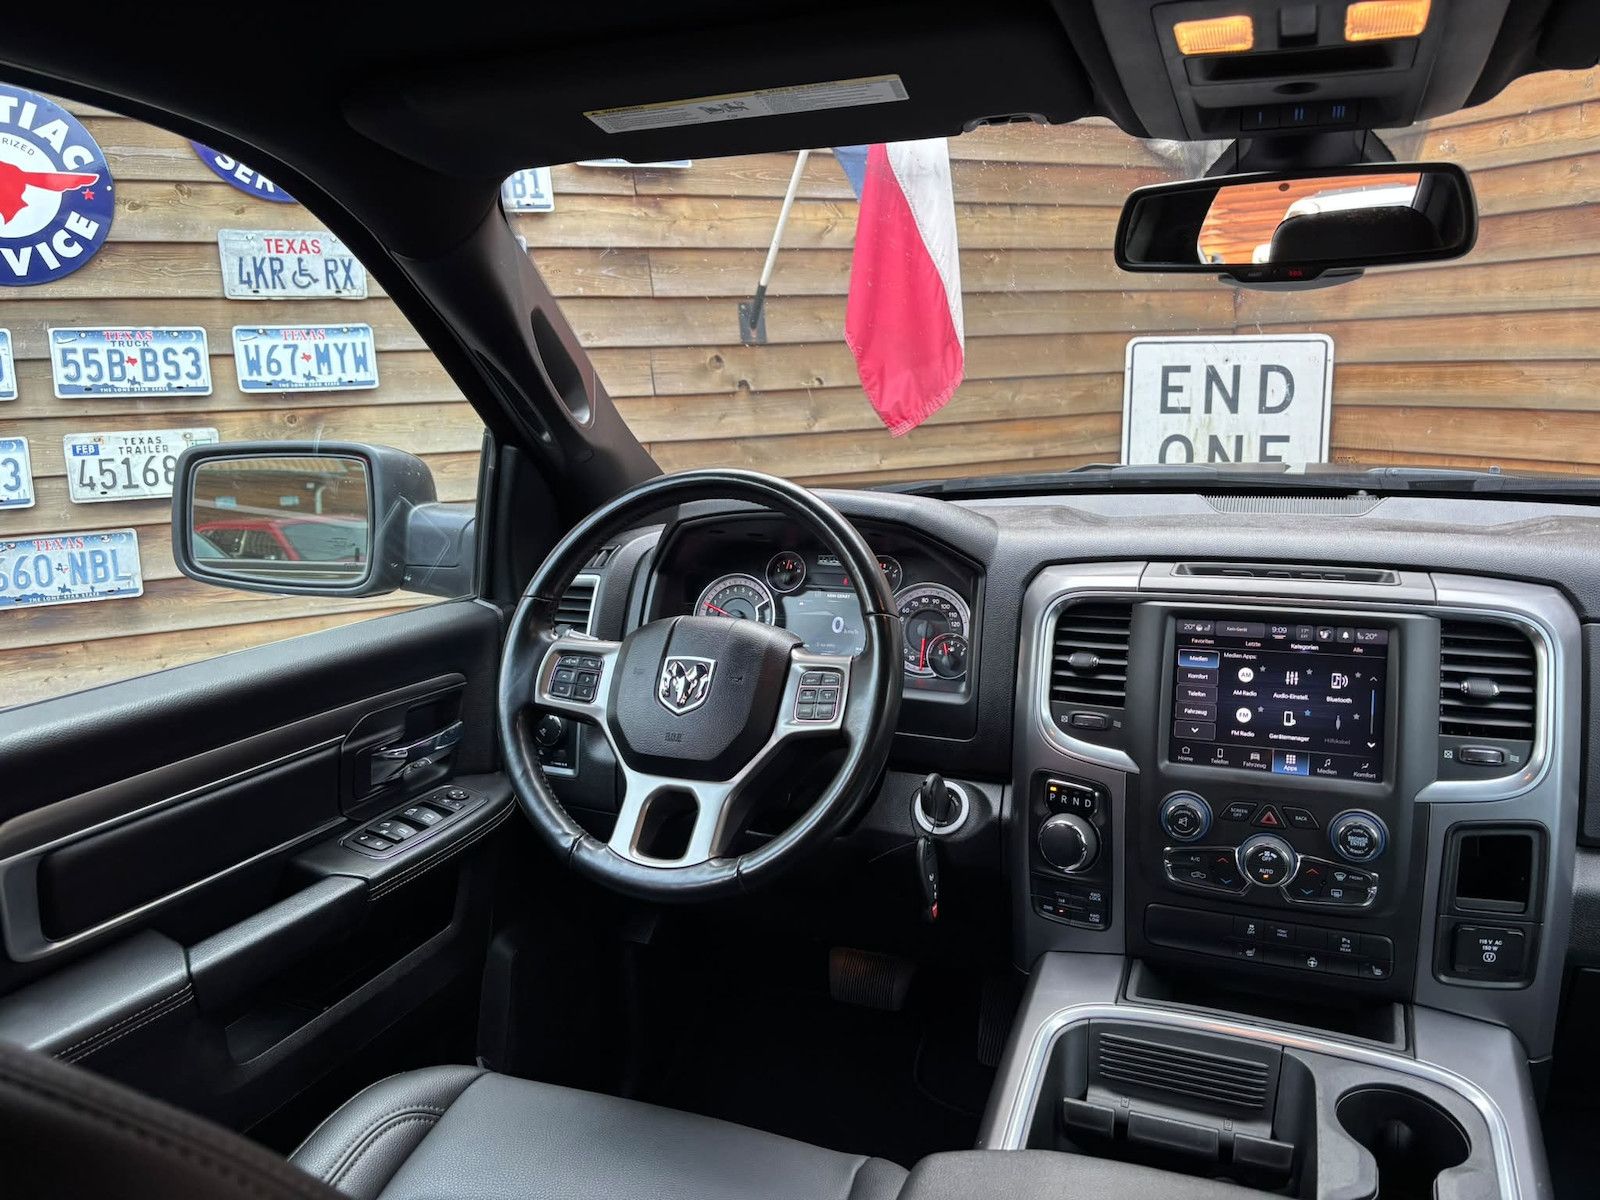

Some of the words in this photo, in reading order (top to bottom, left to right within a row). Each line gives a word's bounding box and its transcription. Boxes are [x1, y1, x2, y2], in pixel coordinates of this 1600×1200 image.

[264, 238, 321, 254] TEXAS
[238, 256, 287, 289] 4KR
[324, 258, 356, 290] RX
[103, 331, 153, 341] TEXAS
[282, 329, 326, 340] TEXAS
[110, 340, 150, 348] TRUCK
[244, 344, 299, 377] W67
[314, 342, 369, 376] MYW
[60, 347, 127, 383] 55B
[139, 346, 201, 382] BS3
[1159, 364, 1295, 414] END
[123, 437, 162, 446] TEXAS
[75, 445, 95, 454] FEB
[118, 445, 169, 455] TRAILER
[1158, 433, 1290, 463] ONE
[79, 455, 177, 491] 45168
[33, 537, 84, 552] TEXAS
[68, 548, 132, 586] NBL
[1271, 626, 1288, 634] 9:09
[1191, 637, 1215, 645] Favoriten
[1290, 643, 1319, 652] Kategorien
[1223, 651, 1243, 659] Medien
[1187, 672, 1209, 680] Komfort
[1240, 671, 1252, 679] AM
[1187, 690, 1206, 698] Telefon
[1326, 695, 1353, 704] Bluetooth
[1184, 708, 1208, 717] Fahrzeug
[1241, 730, 1255, 738] Radio
[1268, 732, 1311, 743] Gerätemanager
[1177, 755, 1194, 763] Home
[1210, 757, 1230, 766] Telefon
[1242, 761, 1267, 770] Fahrzeug
[1283, 764, 1298, 773] Apps
[1316, 768, 1338, 776] Medien
[1353, 771, 1376, 780] Komfort
[1050, 793, 1056, 801] P
[1061, 795, 1068, 804] R
[1072, 797, 1080, 806] N
[1084, 799, 1092, 808] D
[1230, 807, 1248, 815] SCREEN
[1190, 855, 1201, 863] A/C
[1258, 867, 1274, 876] AUTO
